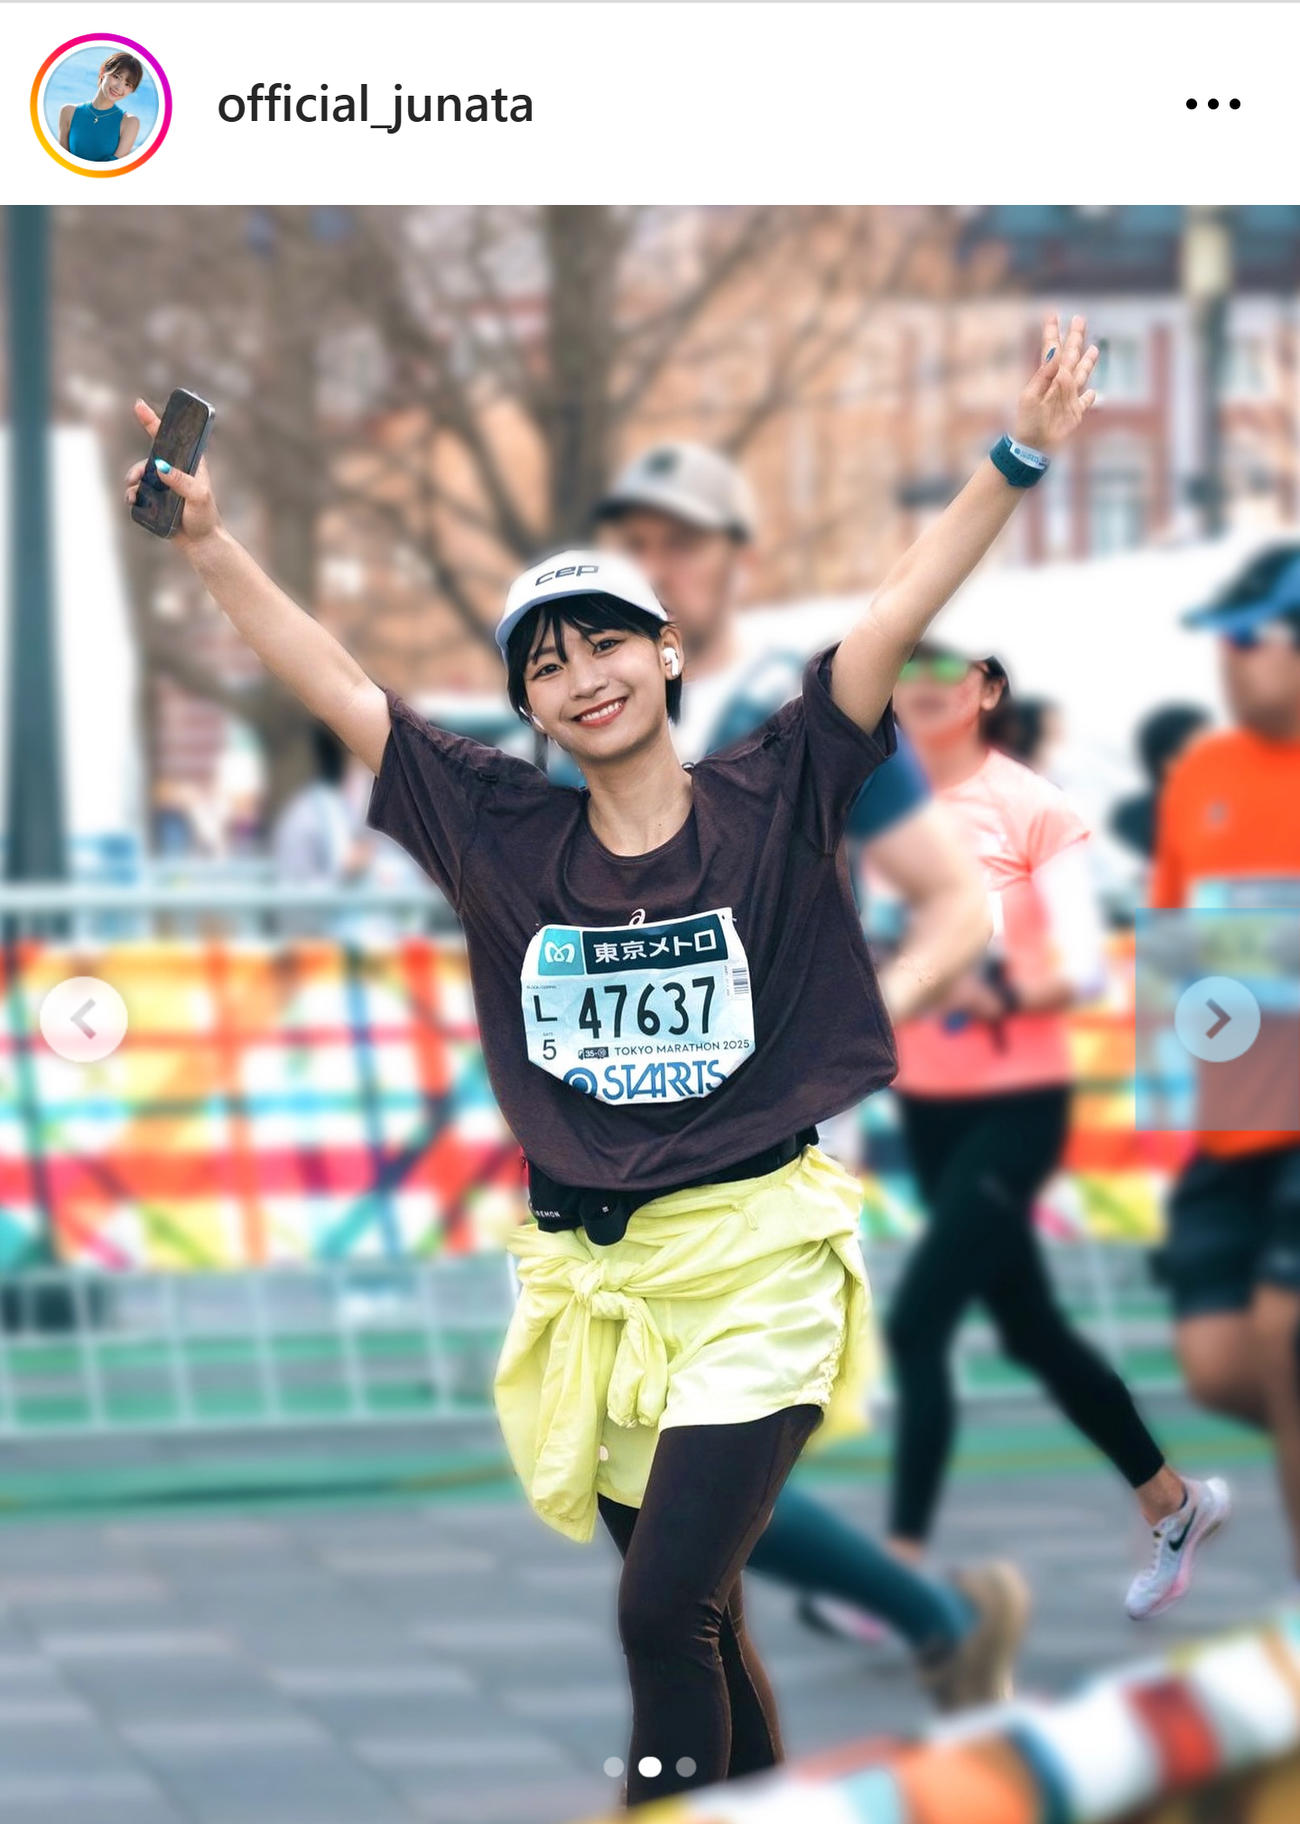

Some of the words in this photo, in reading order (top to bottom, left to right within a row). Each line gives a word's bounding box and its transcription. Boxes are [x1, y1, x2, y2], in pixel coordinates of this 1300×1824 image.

[535, 565, 599, 586] cep
[593, 929, 717, 963] 東京メトロ
[533, 995, 558, 1022] L
[579, 976, 716, 1038] 47637
[543, 1039, 557, 1060] 5
[614, 1046, 653, 1056] TOKYO
[656, 1041, 720, 1054] MARATHON
[723, 1039, 750, 1049] 2025
